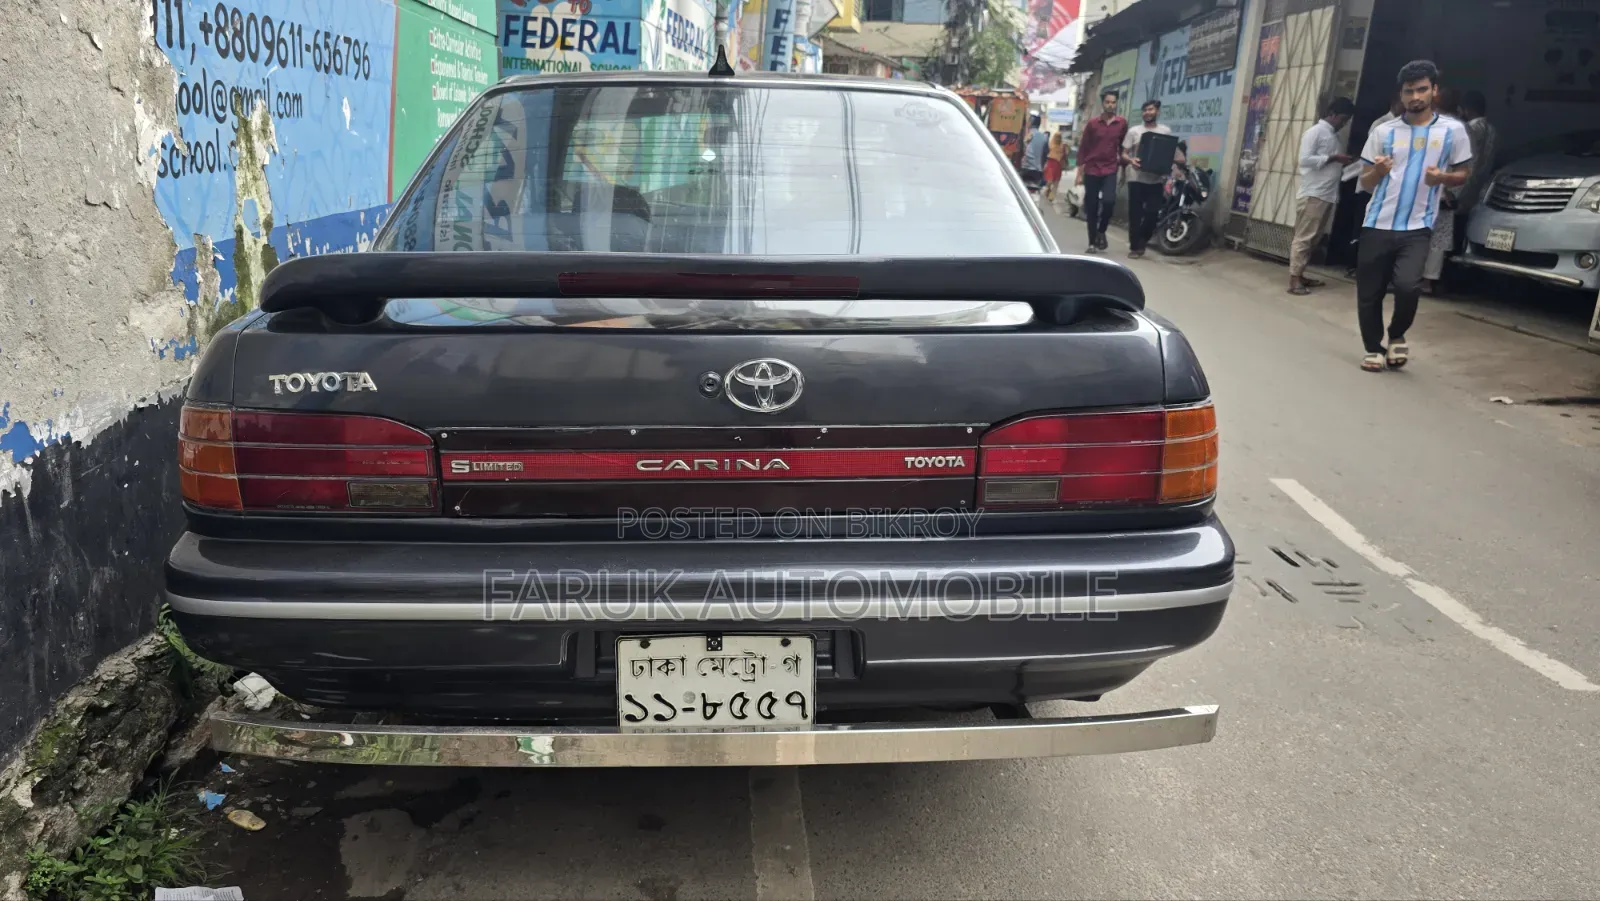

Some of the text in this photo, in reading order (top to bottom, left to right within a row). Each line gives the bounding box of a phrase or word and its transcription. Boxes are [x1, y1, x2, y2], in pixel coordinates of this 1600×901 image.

[567, 0, 592, 15] TO
[200, 2, 371, 81] +8809611-656796
[503, 14, 637, 55] FEDERAL
[502, 56, 582, 73] INTERNATIONAL
[175, 68, 303, 132] ool@gmil.com
[269, 371, 378, 396] TOYOTA
[472, 462, 524, 472] LIMITED
[636, 458, 790, 471] CARINA
[904, 456, 965, 469] TOYOTA
[630, 654, 688, 678] ঢাকা
[624, 690, 808, 722] ১১-৮৫৫৭
